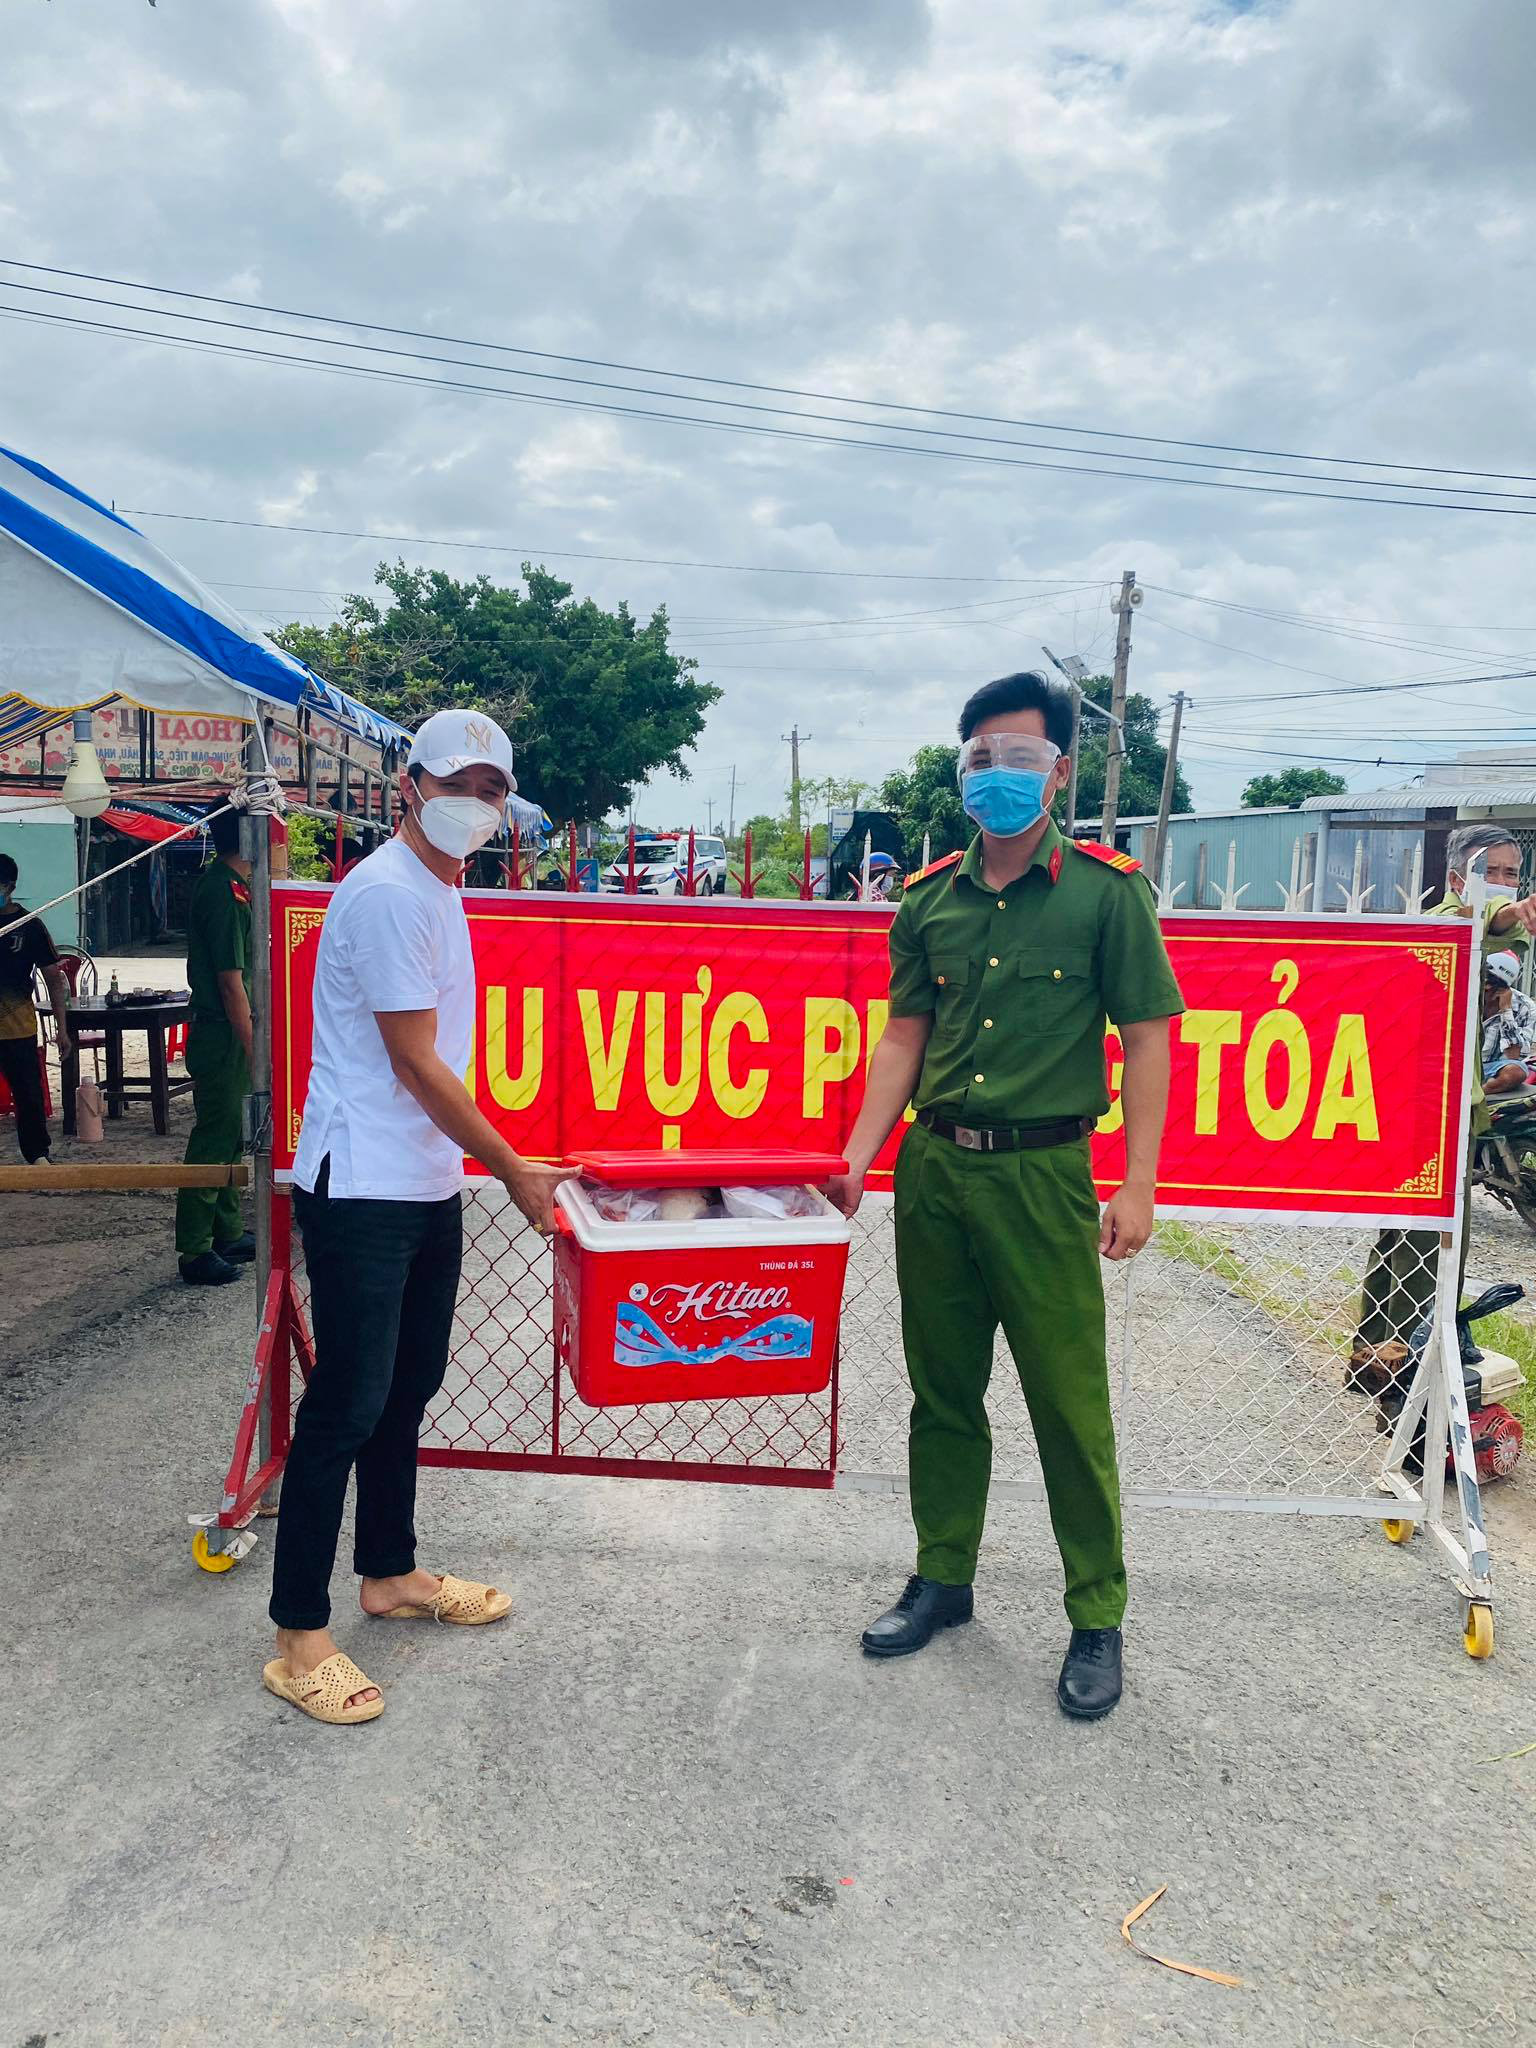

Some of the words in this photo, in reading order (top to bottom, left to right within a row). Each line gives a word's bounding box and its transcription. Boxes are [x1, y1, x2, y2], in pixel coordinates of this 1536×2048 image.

[578, 965, 770, 1151] VỰC
[1180, 960, 1380, 1142] TỎA
[801, 1260, 815, 1269] 35L
[650, 1281, 789, 1324] Hitaco
